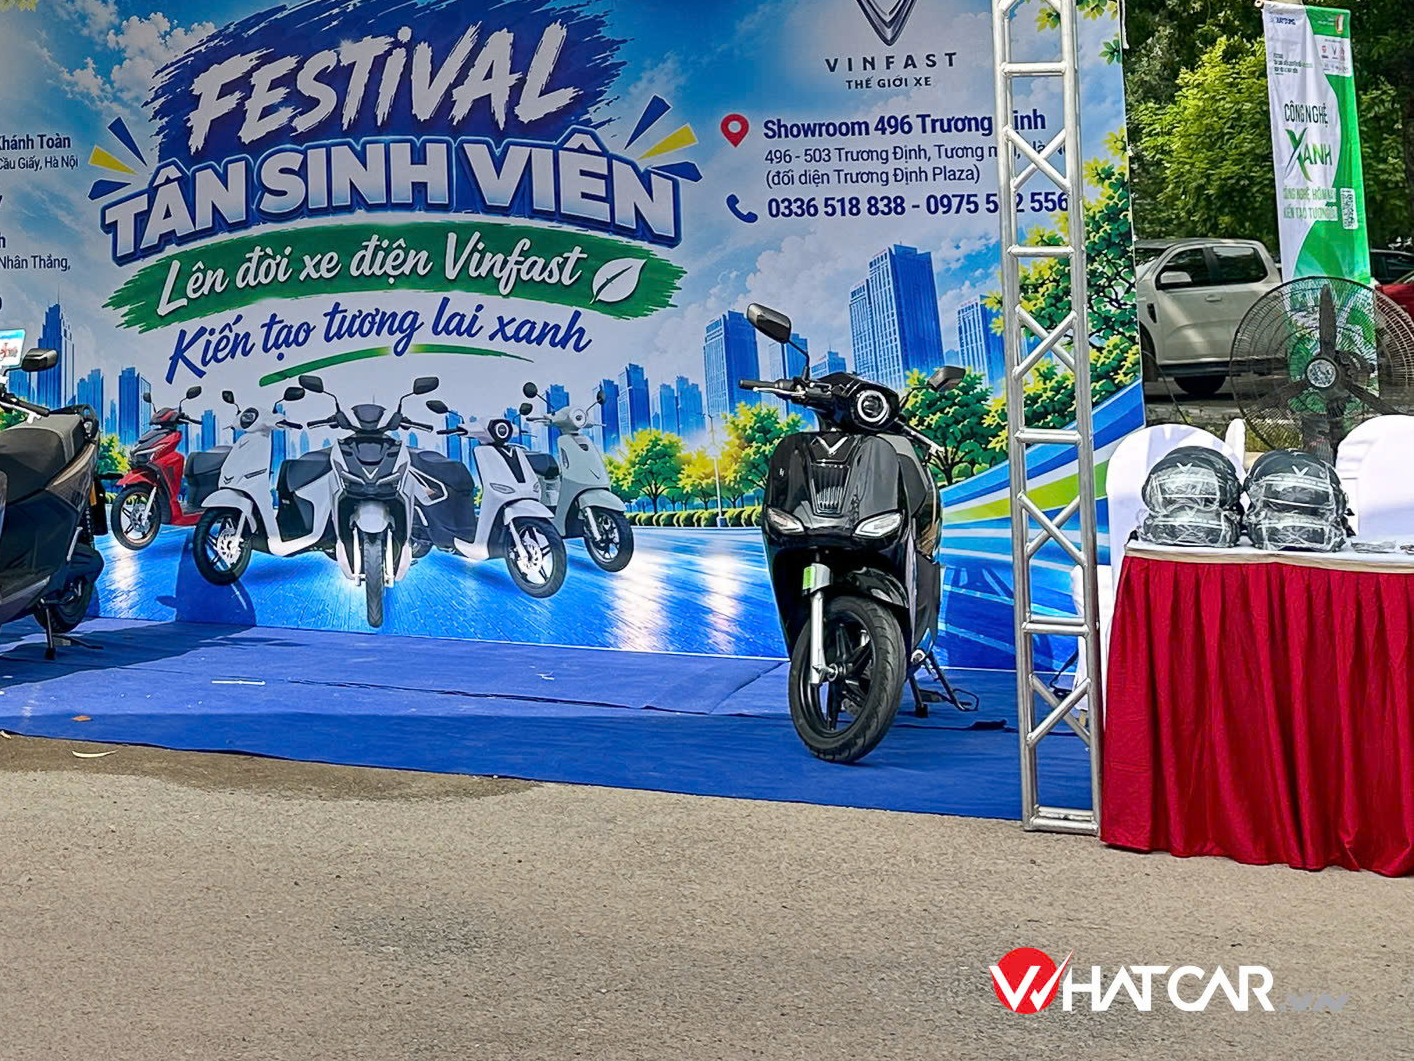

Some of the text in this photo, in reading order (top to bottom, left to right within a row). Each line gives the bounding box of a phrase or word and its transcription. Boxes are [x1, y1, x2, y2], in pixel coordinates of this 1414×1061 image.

[825, 52, 957, 73] VINFAST
[846, 74, 932, 90] THẾ GIỚI XE
[763, 108, 1047, 139] Showroom 496 Trương ịnh
[1284, 100, 1305, 123] CÔNG
[37, 133, 71, 149] Toàn
[18, 154, 43, 171] Giấy,
[45, 155, 58, 169] Hà
[61, 154, 79, 171] Nội
[764, 148, 792, 164] 496
[804, 148, 831, 163] 503
[835, 147, 889, 164] Trương
[892, 144, 931, 164] Định,
[934, 144, 984, 161] Tương
[1285, 127, 1333, 182] XANH
[766, 164, 980, 189] (đối diện Trương Định Plaza)
[105, 131, 677, 258] TÂN SINH VIÊN
[767, 197, 818, 217] 0336
[824, 196, 861, 217] 518
[867, 195, 906, 216] 838
[926, 193, 979, 215] 0975
[986, 192, 1025, 214] 52
[1030, 191, 1069, 213] 556
[156, 231, 589, 317] Lên đời xe điện Vinfast
[165, 296, 592, 385] Kiến tạo tương lai xanh
